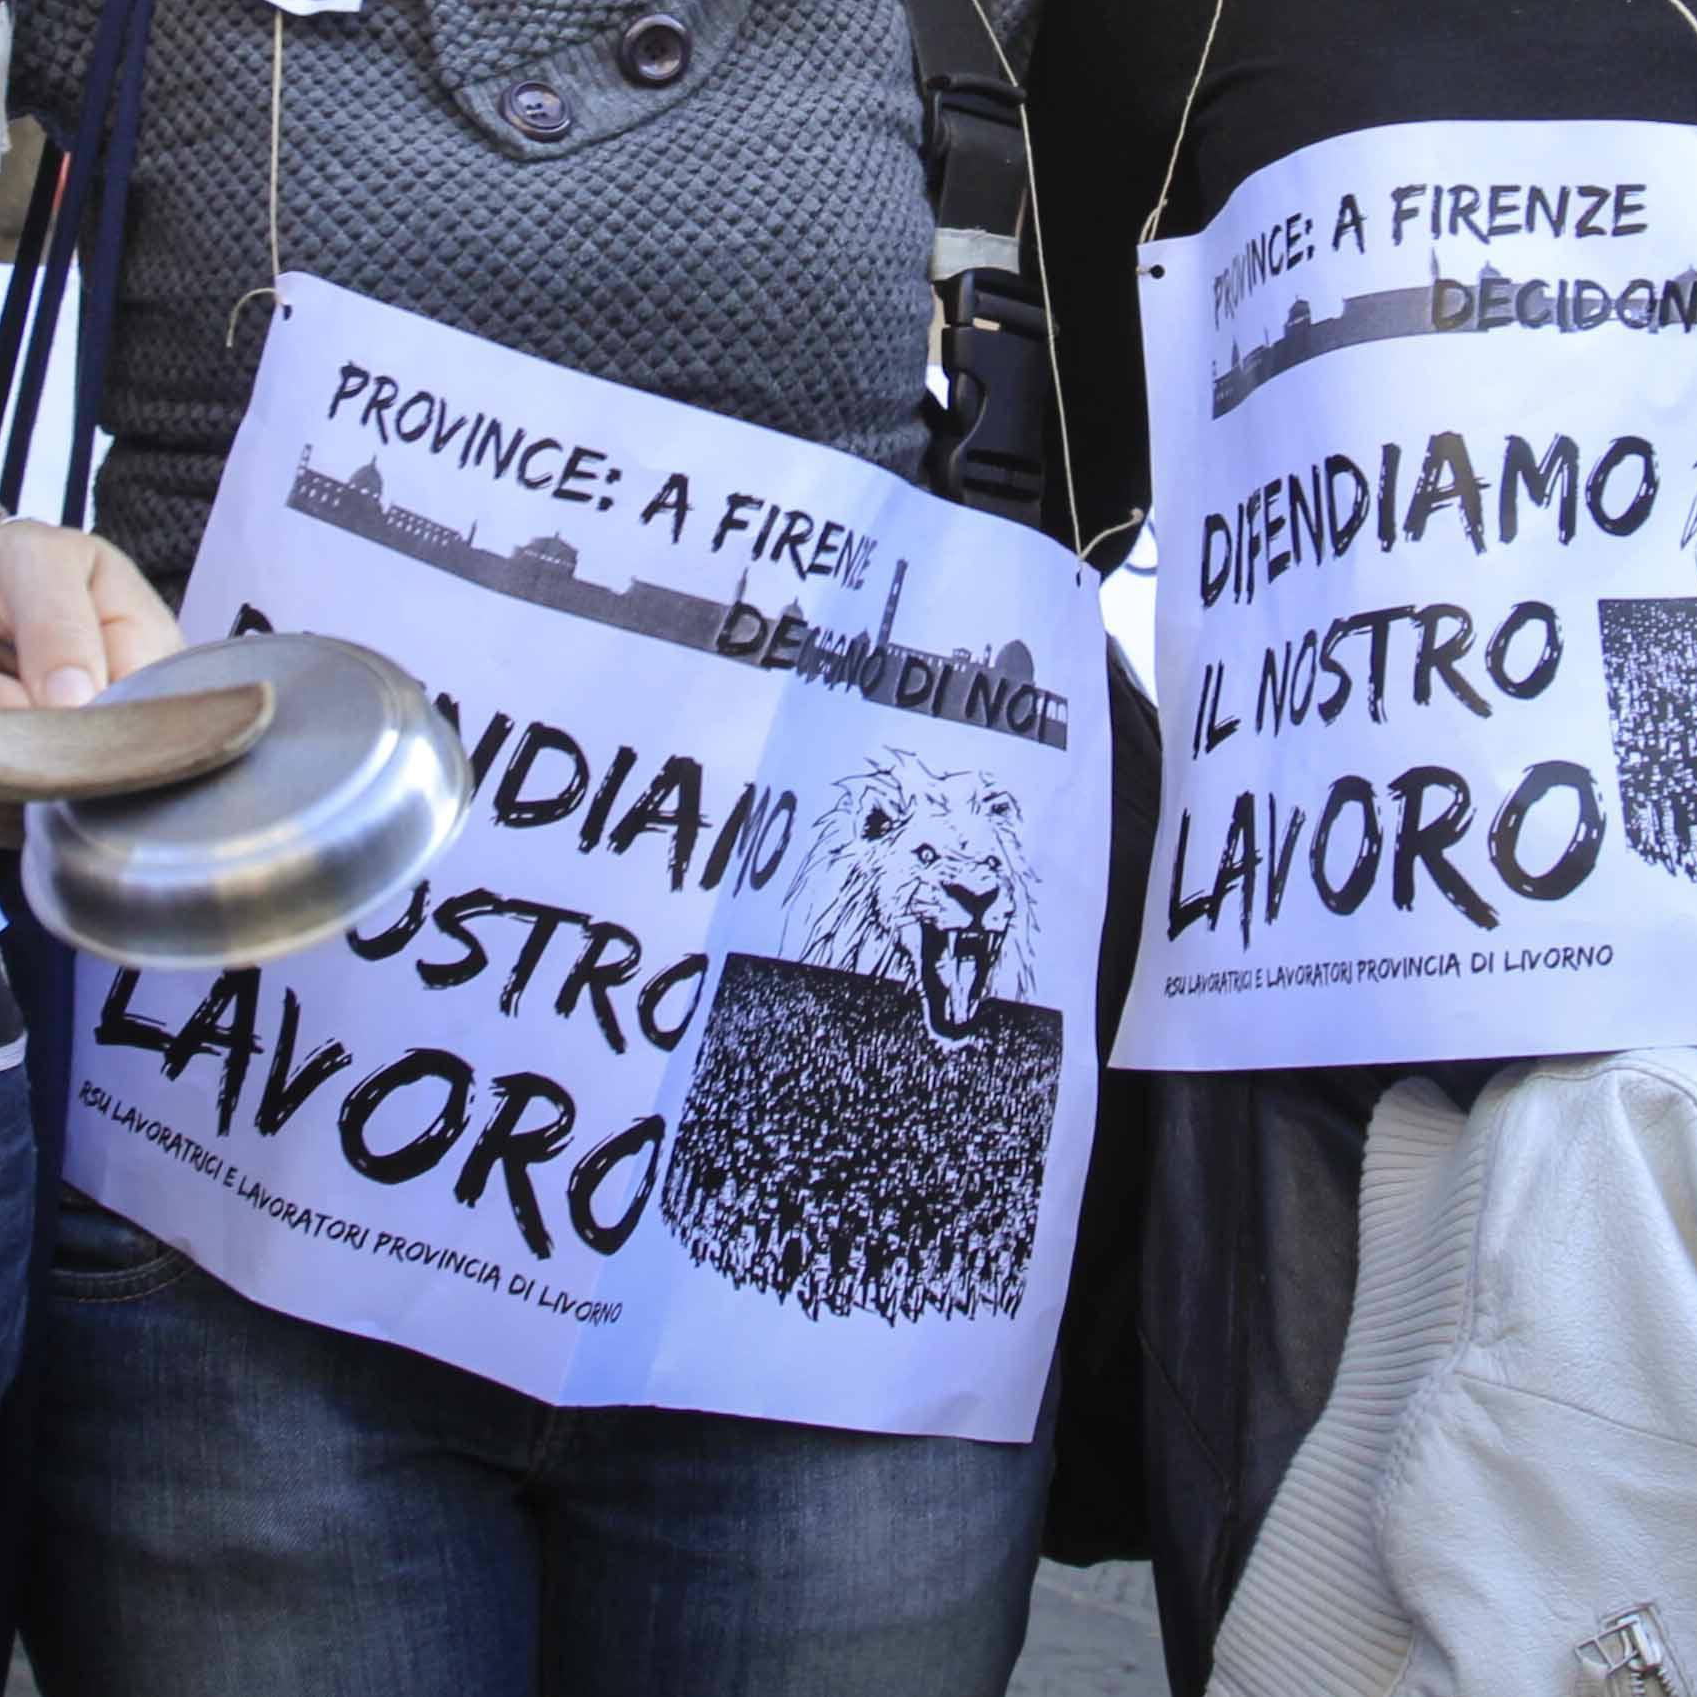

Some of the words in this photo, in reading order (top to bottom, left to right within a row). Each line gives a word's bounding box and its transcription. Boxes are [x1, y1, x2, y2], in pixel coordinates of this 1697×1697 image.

[1213, 212, 1316, 332] PROVINCE:
[1331, 193, 1367, 255] A
[1390, 183, 1649, 246] FIRENZE
[327, 360, 623, 512] PROVINCE:
[639, 471, 695, 545] A
[1200, 430, 1661, 610] DIFENDIAMO
[893, 655, 952, 719] DI
[964, 670, 1053, 746] NOI
[1192, 660, 1243, 761] IL
[1255, 600, 1564, 739] NOSTRO
[1166, 759, 1608, 952] LAVORO
[1163, 974, 1188, 999] RSU
[1255, 971, 1264, 990] E
[1267, 961, 1354, 989] LAVORATORI
[1356, 953, 1461, 983] PROVINCIA
[1470, 950, 1495, 974] DI
[1503, 943, 1615, 972] LIVORNO
[94, 964, 667, 1260] LAVORO
[77, 1079, 111, 1115] RSU
[110, 1100, 223, 1182] LAVORATRICI
[222, 1165, 240, 1190] E
[236, 1179, 368, 1251] LAVORATORI
[373, 1230, 503, 1289] PROVINCIA
[508, 1272, 536, 1303] DI
[538, 1284, 625, 1327] LIVORNO
